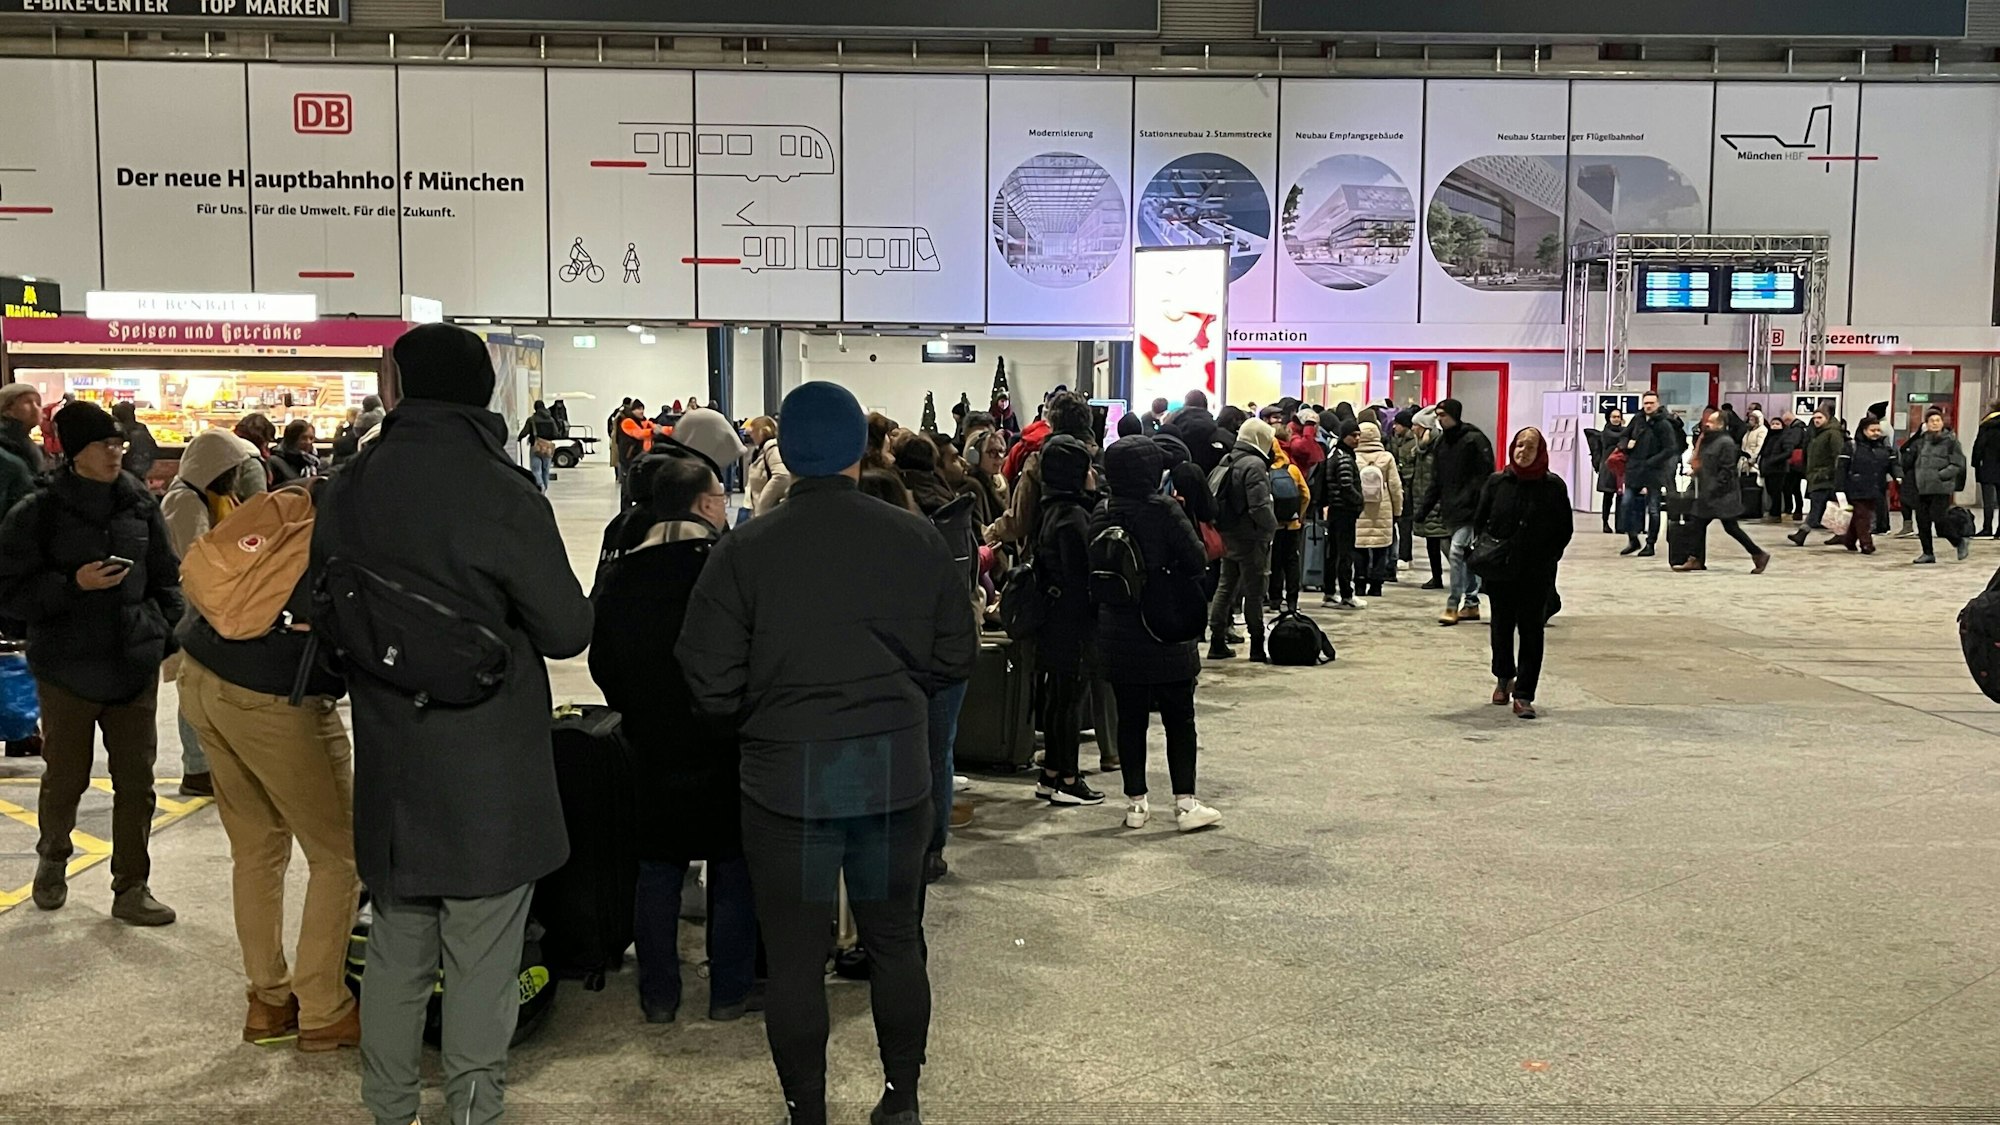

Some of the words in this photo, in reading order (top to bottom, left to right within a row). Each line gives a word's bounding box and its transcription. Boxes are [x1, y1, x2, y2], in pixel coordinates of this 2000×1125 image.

[23, 0, 169, 13] E-BIKE-CENTER
[200, 0, 235, 14] TOP
[246, 0, 329, 16] MARKEN
[300, 98, 346, 129] DB
[1029, 130, 1093, 138] Modernisierung
[1330, 132, 1403, 140] Empfangsgebäude
[1587, 133, 1644, 141] Flügelbahnhof
[1738, 152, 1782, 160] München
[118, 168, 158, 186] Der
[165, 173, 221, 187] neue
[419, 172, 523, 191] München
[197, 204, 216, 213] Für
[221, 205, 246, 214] Uns.
[255, 205, 274, 214] Für
[278, 205, 296, 215] die
[300, 206, 350, 215] Umwelt.
[354, 206, 373, 215] Für
[378, 206, 395, 216] die
[404, 207, 455, 217] Zukunft.
[108, 319, 178, 341] Speisen
[184, 322, 214, 340] und
[221, 321, 302, 344] Getränke
[1227, 329, 1307, 342] nformation
